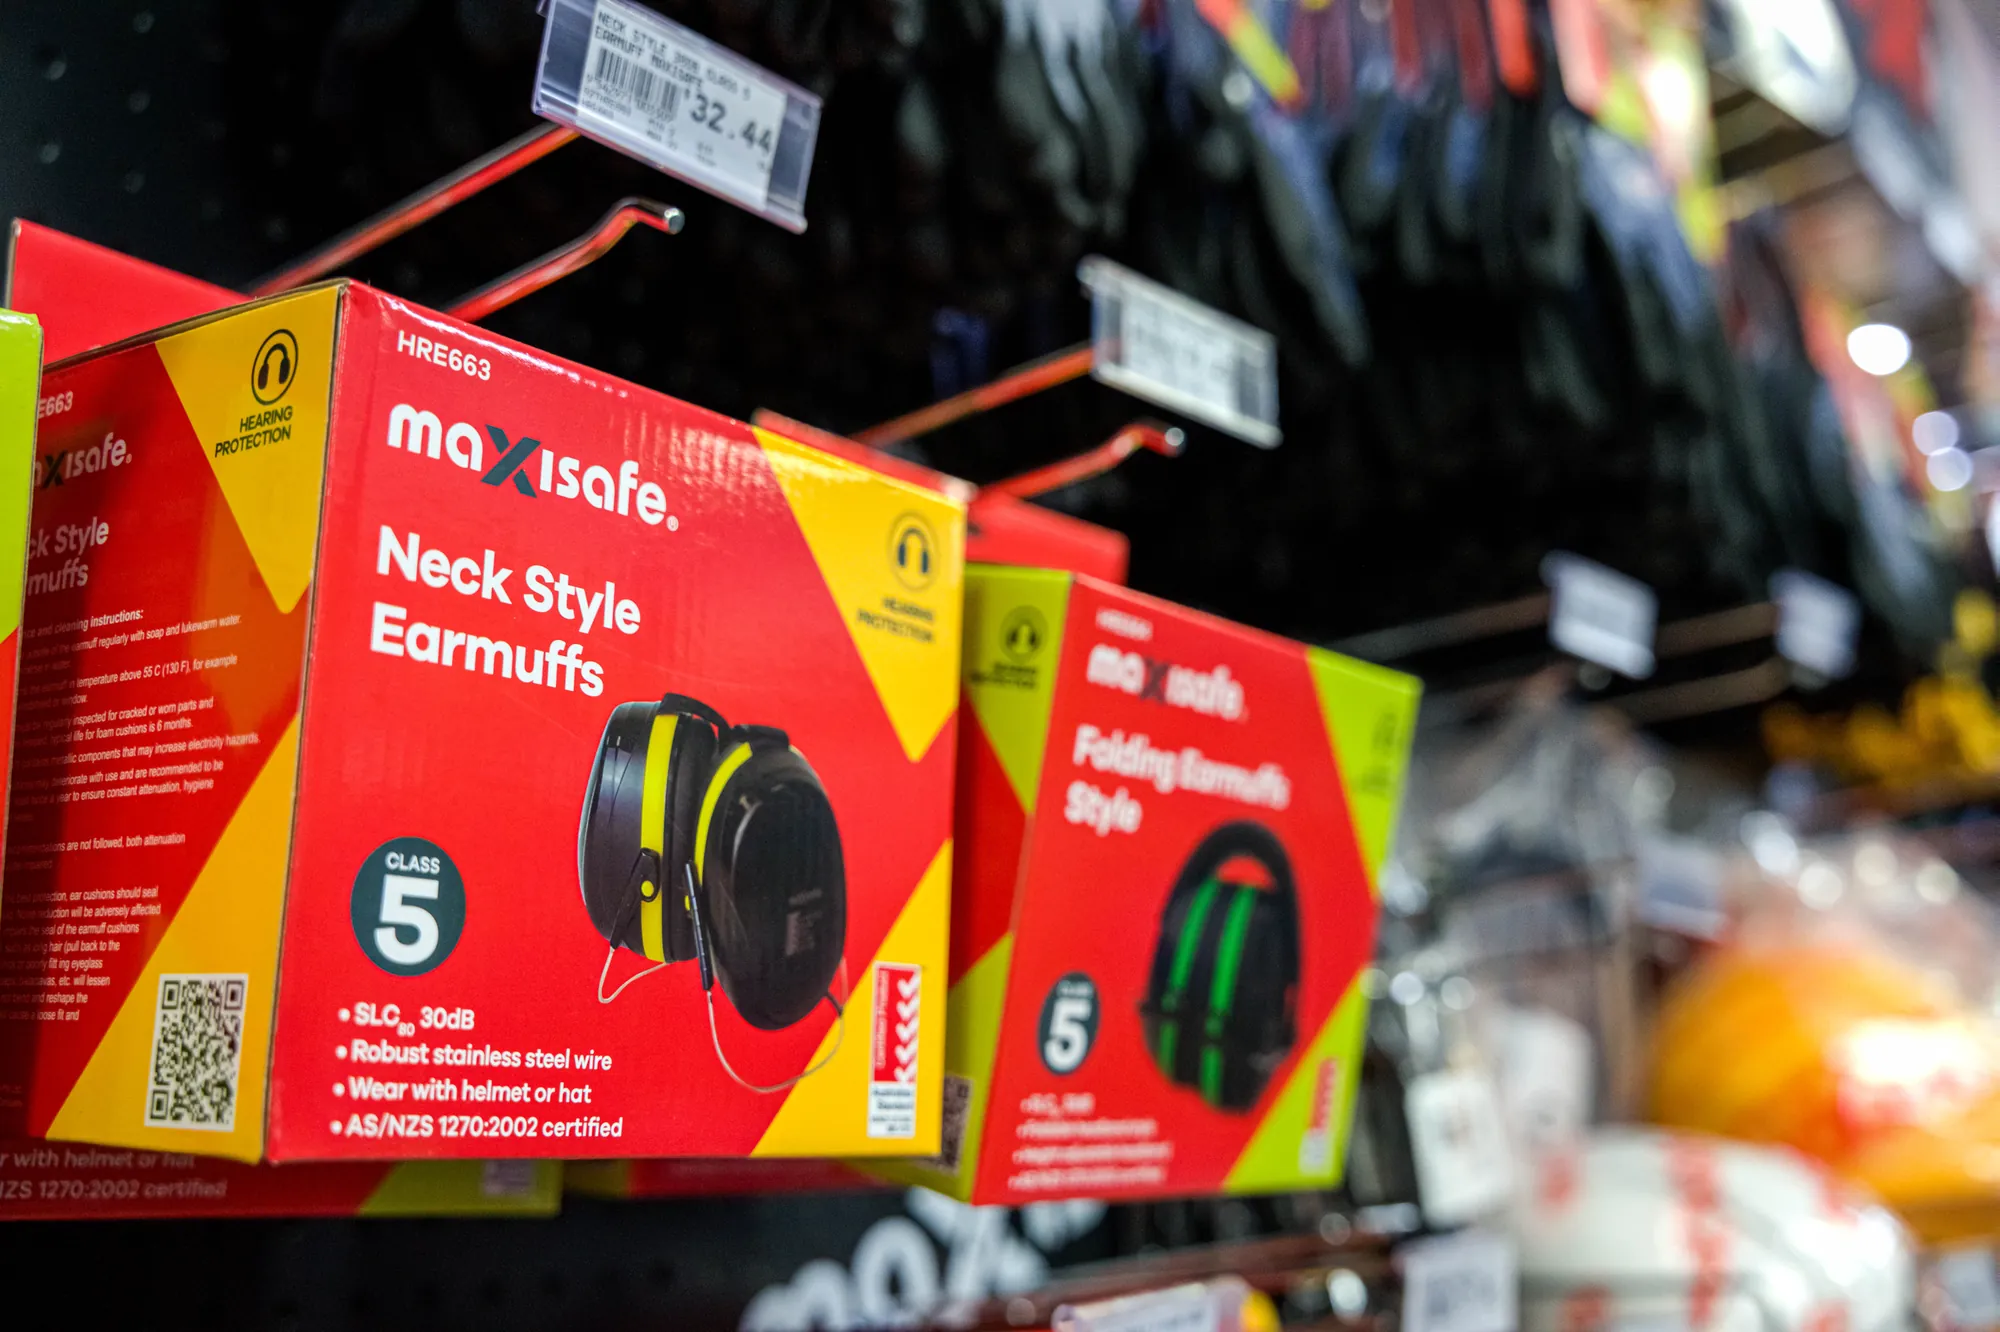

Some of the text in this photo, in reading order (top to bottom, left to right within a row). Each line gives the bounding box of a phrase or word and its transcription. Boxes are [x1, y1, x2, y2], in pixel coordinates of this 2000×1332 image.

[595, 25, 645, 58] EARMUFF
[598, 10, 627, 34] NECK
[632, 28, 668, 56] STYLE
[396, 329, 492, 381] HRE663
[37, 390, 74, 419] E663
[239, 405, 294, 433] HEARING
[214, 424, 292, 458] PROTECTION
[27, 516, 110, 560] ck Style
[26, 556, 89, 597] muffs
[376, 524, 642, 635] Neck Style
[54, 620, 89, 634] cleaning
[98, 633, 130, 649] regularly
[130, 630, 145, 642] with
[146, 628, 165, 640] soap
[165, 623, 181, 636] and
[181, 619, 218, 633] lukewarm
[370, 601, 605, 697] Earmuffs
[76, 674, 119, 688] temperature
[119, 670, 142, 681] above
[143, 666, 153, 678] 55
[154, 664, 161, 676] C
[192, 658, 204, 670] for
[204, 654, 238, 668] example
[72, 711, 107, 726] inspected
[107, 710, 118, 720] for
[118, 705, 148, 719] cracked
[148, 706, 158, 716] or
[157, 704, 177, 714] worn
[177, 700, 197, 714] parts
[198, 696, 214, 709] and
[72, 730, 84, 741] life
[84, 729, 95, 740] for
[96, 728, 114, 738] foam
[115, 724, 148, 736] cushions
[148, 722, 156, 732] is
[156, 720, 163, 731] 6
[77, 748, 121, 763] components
[122, 746, 137, 757] that
[137, 746, 154, 758] may
[154, 742, 187, 754] increase
[187, 736, 224, 750] electricity
[89, 771, 104, 783] with
[104, 772, 118, 781] use
[119, 768, 134, 780] and
[134, 769, 148, 779] are
[148, 761, 203, 777] recommended
[203, 761, 212, 772] to
[212, 759, 224, 771] be
[72, 791, 80, 801] to
[80, 790, 106, 800] ensure
[106, 785, 138, 798] constant
[183, 779, 214, 794] hygiene
[66, 842, 79, 851] are
[79, 839, 92, 850] not
[125, 835, 143, 847] both
[143, 832, 187, 846] attenuation
[384, 852, 441, 875] CLASS
[69, 892, 82, 901] ear
[82, 889, 116, 900] cushions
[115, 886, 142, 899] should
[141, 885, 160, 898] seal
[70, 906, 83, 917] will
[83, 906, 94, 917] be
[94, 905, 131, 918] adversely
[130, 904, 162, 916] affected
[373, 873, 440, 966] 5
[56, 924, 65, 935] of
[65, 924, 77, 934] the
[78, 922, 107, 934] earmuff
[106, 922, 140, 934] cushions
[49, 941, 63, 952] hair
[63, 940, 80, 954] (pull
[80, 940, 98, 951] back
[99, 941, 107, 951] to
[107, 940, 121, 951] the
[58, 960, 70, 971] ing
[71, 958, 104, 971] eyeglass
[73, 975, 86, 985] will
[86, 975, 111, 986] lessen
[45, 992, 75, 1005] reshape
[76, 992, 89, 1003] the
[36, 1010, 56, 1020] loose
[56, 1009, 65, 1020] fit
[65, 1010, 81, 1021] and
[419, 1006, 475, 1030] 30dB
[1043, 997, 1093, 1073] 5
[350, 1039, 612, 1071] Robust stainless steel wire
[348, 1075, 592, 1104] Wear with helmet or hat
[345, 1112, 623, 1139] AS/NZS 1270:2002 certified
[14, 1148, 59, 1168] with
[64, 1149, 133, 1169] helmet
[139, 1154, 158, 1169] or
[39, 1179, 141, 1199] 1270:2002
[143, 1178, 228, 1198] certified
